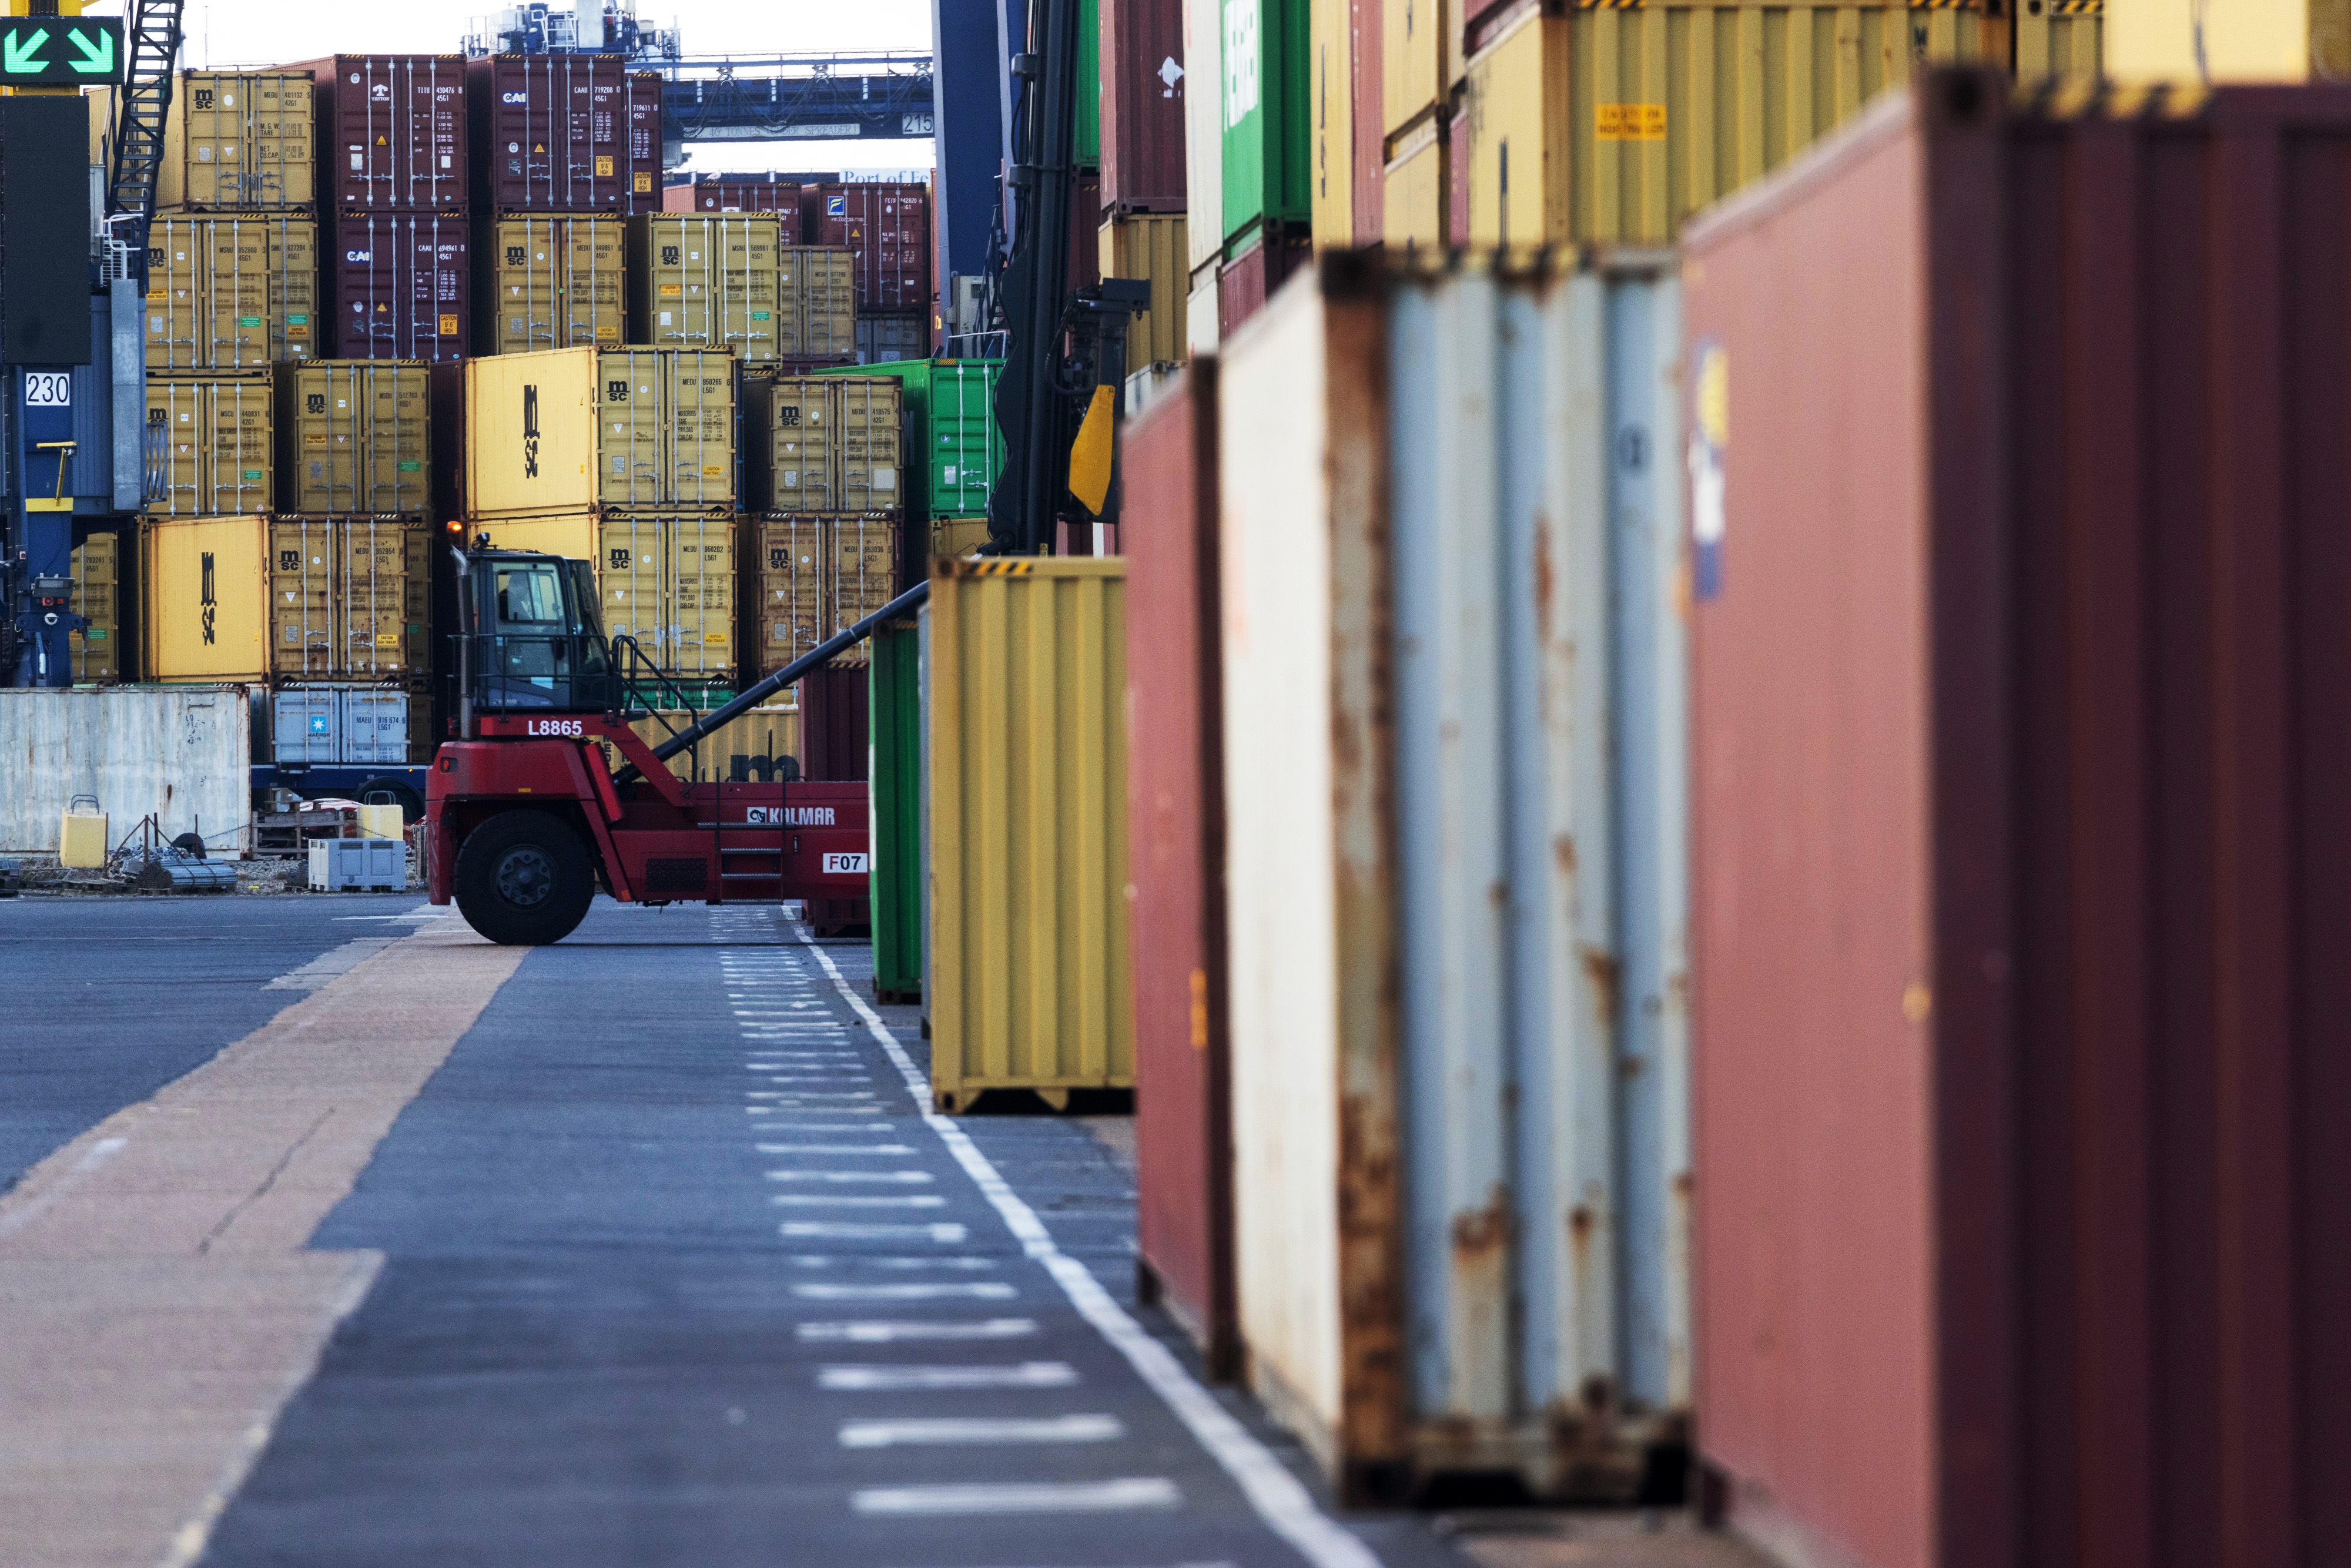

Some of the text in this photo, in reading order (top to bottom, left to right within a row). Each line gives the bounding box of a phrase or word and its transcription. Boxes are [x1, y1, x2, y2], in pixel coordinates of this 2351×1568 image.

[503, 93, 526, 103] CAI
[904, 113, 932, 132] 215
[845, 171, 879, 183] Port
[888, 170, 906, 183] of
[347, 251, 370, 261] CAI
[27, 375, 70, 403] 230
[528, 721, 582, 736] L8865
[769, 807, 835, 825] KALMAR
[829, 856, 862, 870] F07
